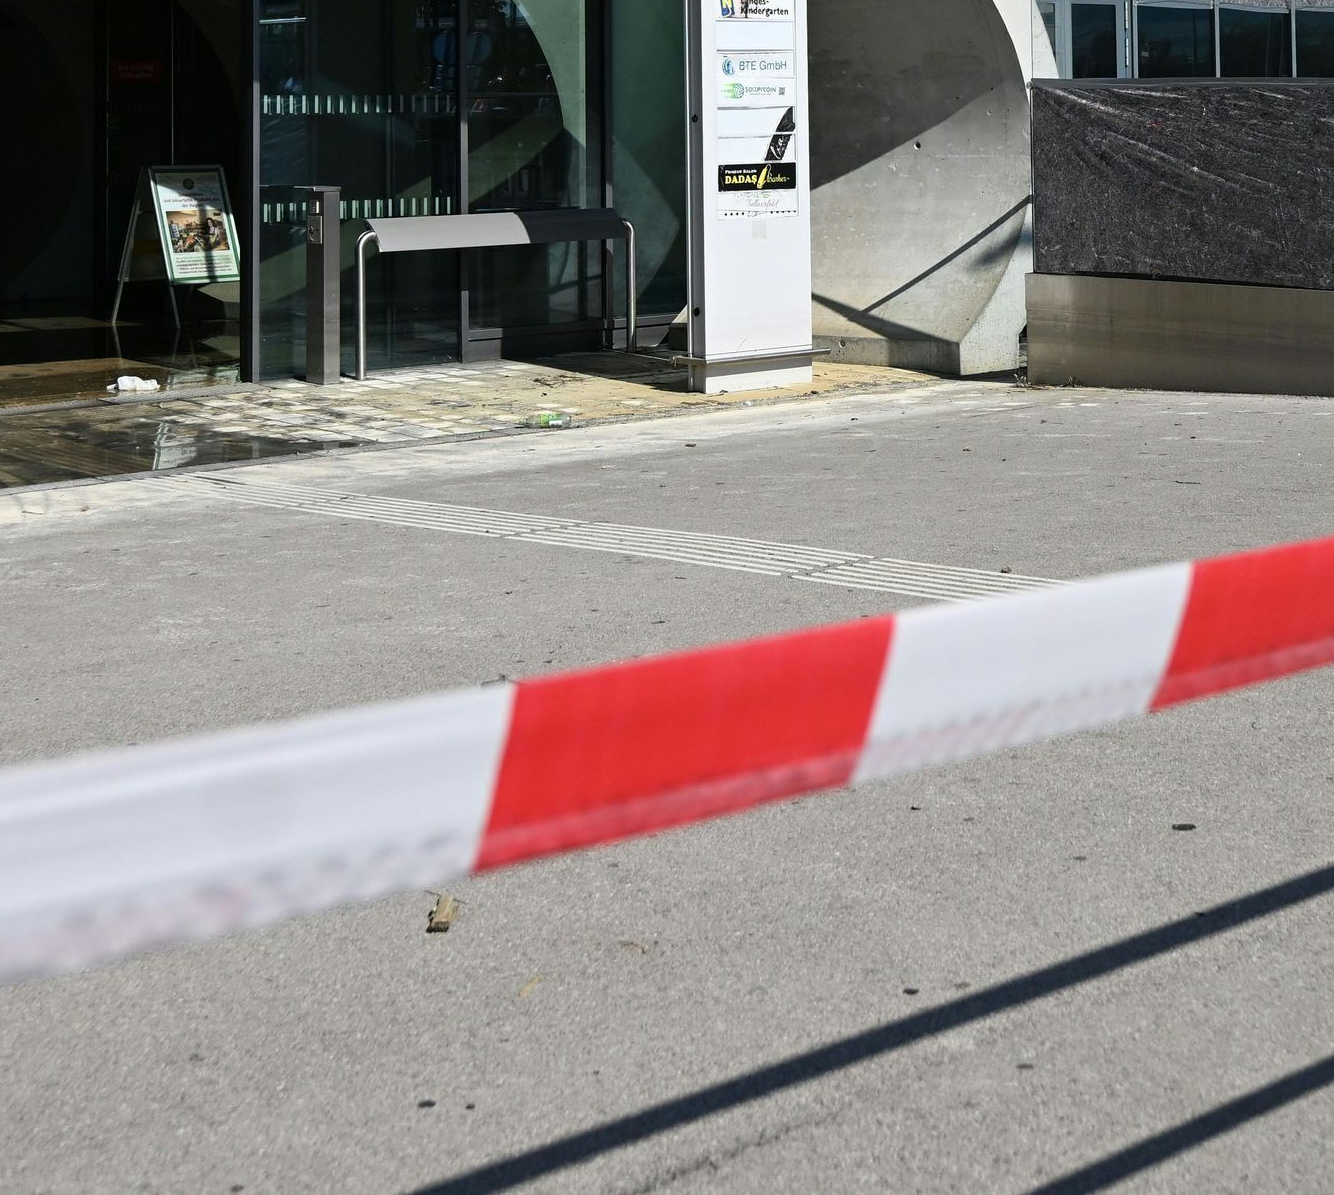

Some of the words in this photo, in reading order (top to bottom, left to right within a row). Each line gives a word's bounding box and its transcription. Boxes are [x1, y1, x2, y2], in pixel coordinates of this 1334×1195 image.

[740, 6, 789, 17] Kindergarten
[739, 61, 756, 71] BTE
[759, 60, 787, 71] GmbH
